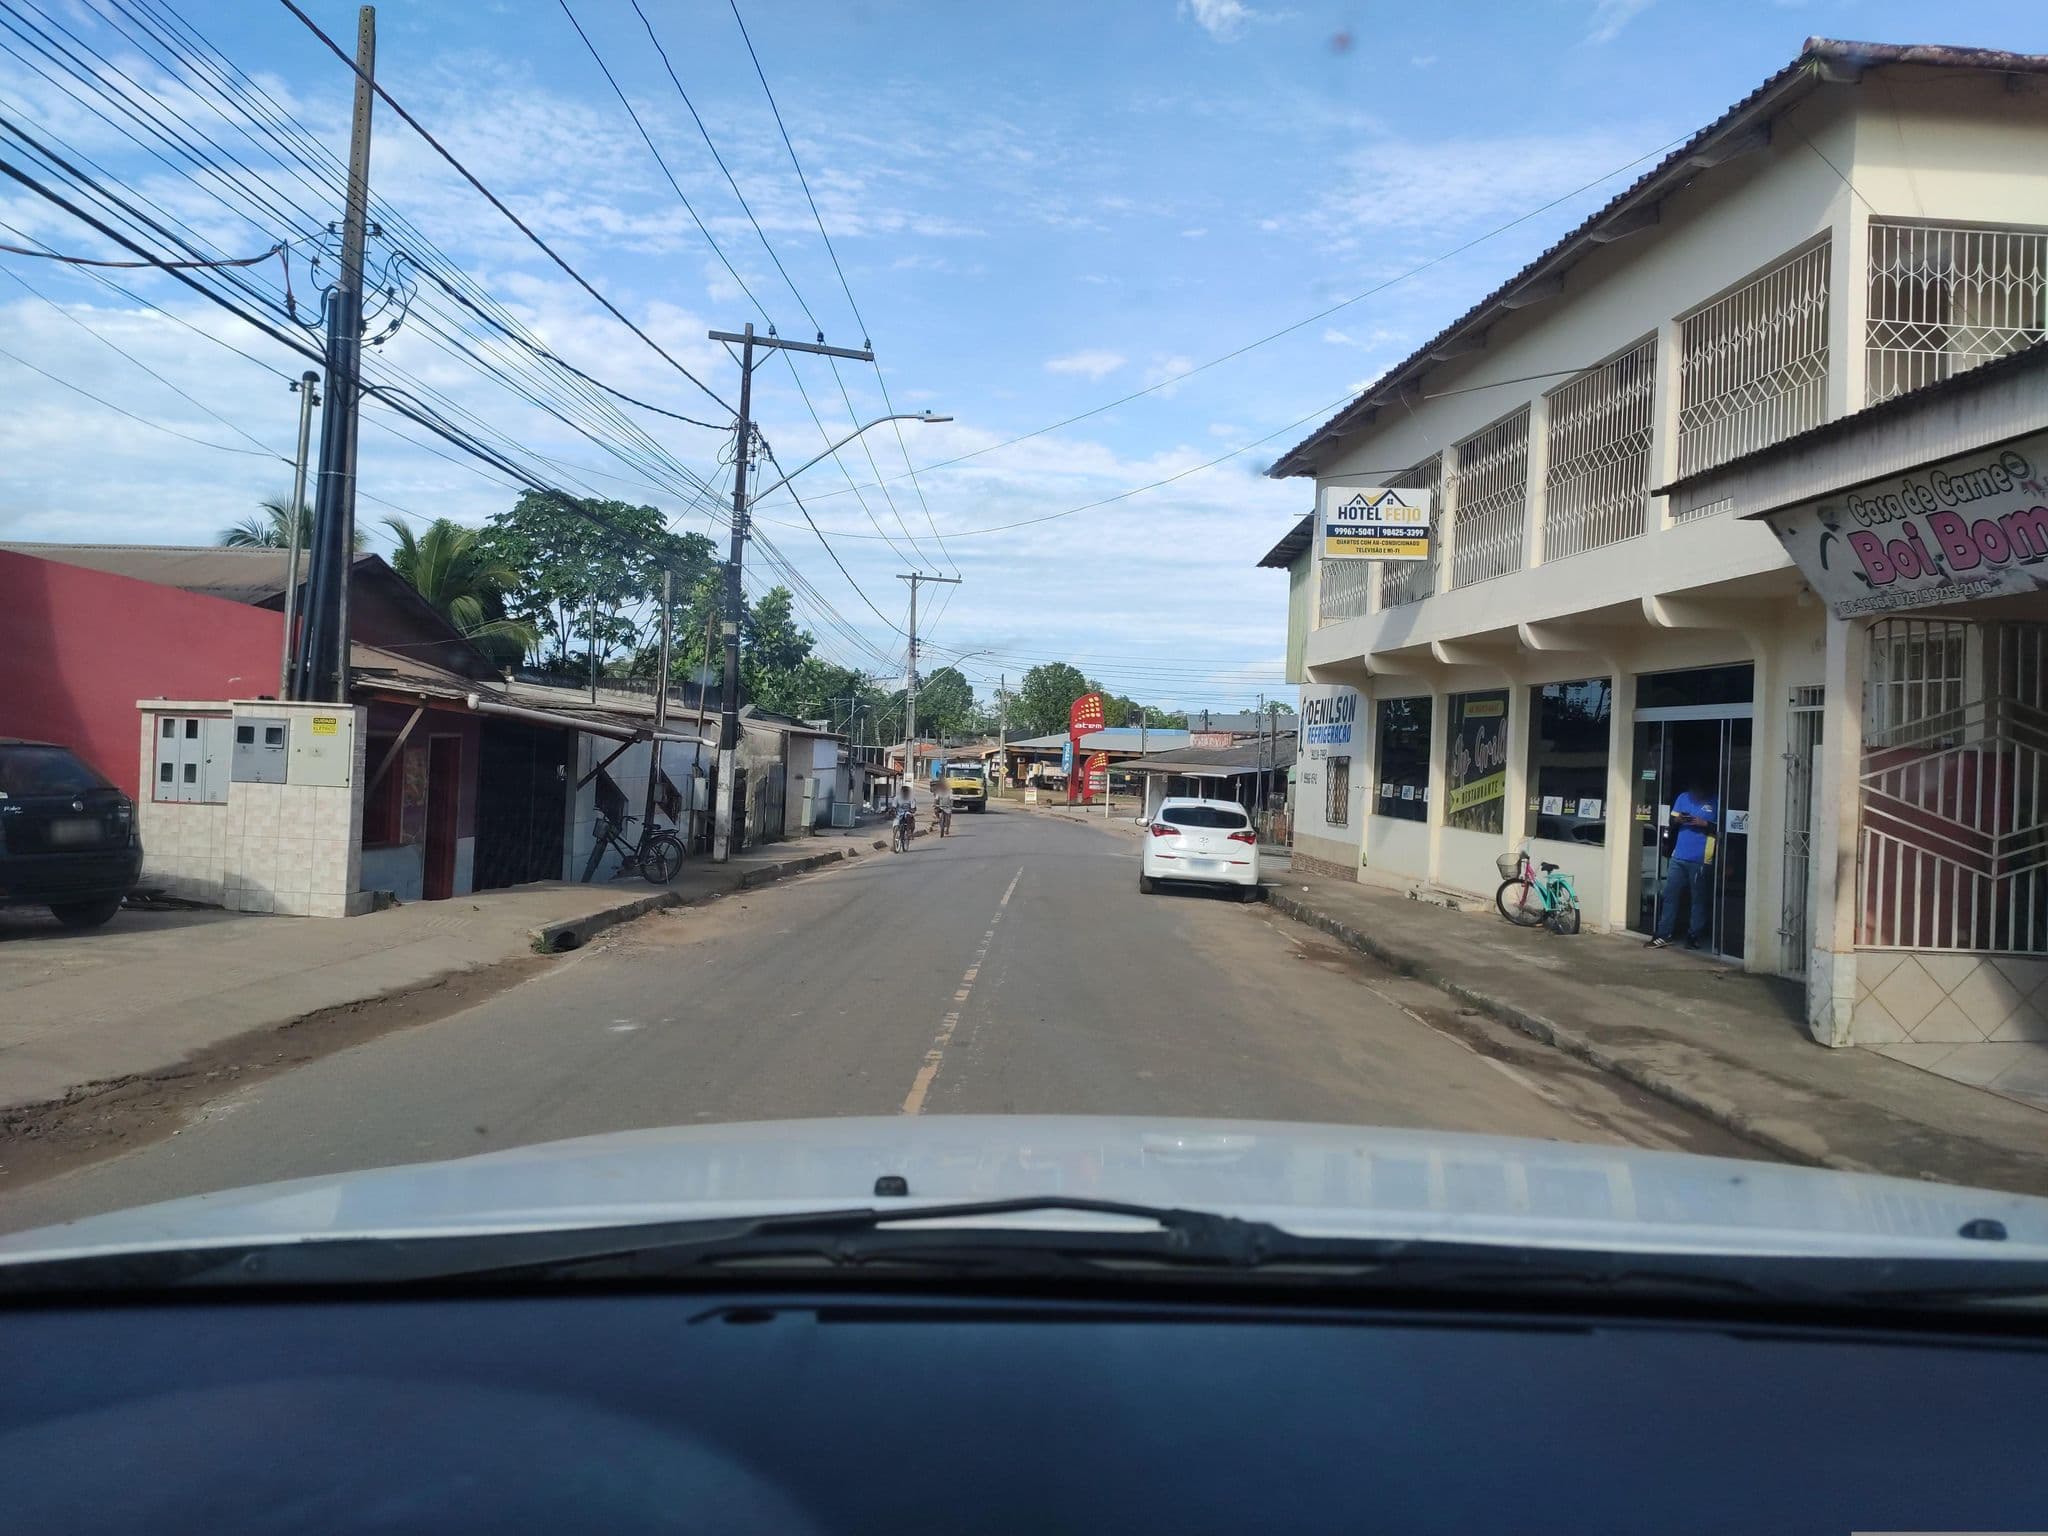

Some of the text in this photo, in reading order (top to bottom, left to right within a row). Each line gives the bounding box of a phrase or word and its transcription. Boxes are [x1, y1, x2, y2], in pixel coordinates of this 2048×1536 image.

[1338, 506, 1382, 520] HOTEL
[1847, 463, 2014, 528] Casa de Carne
[1847, 521, 1938, 586] Boi
[1307, 694, 1357, 726] DENILSON
